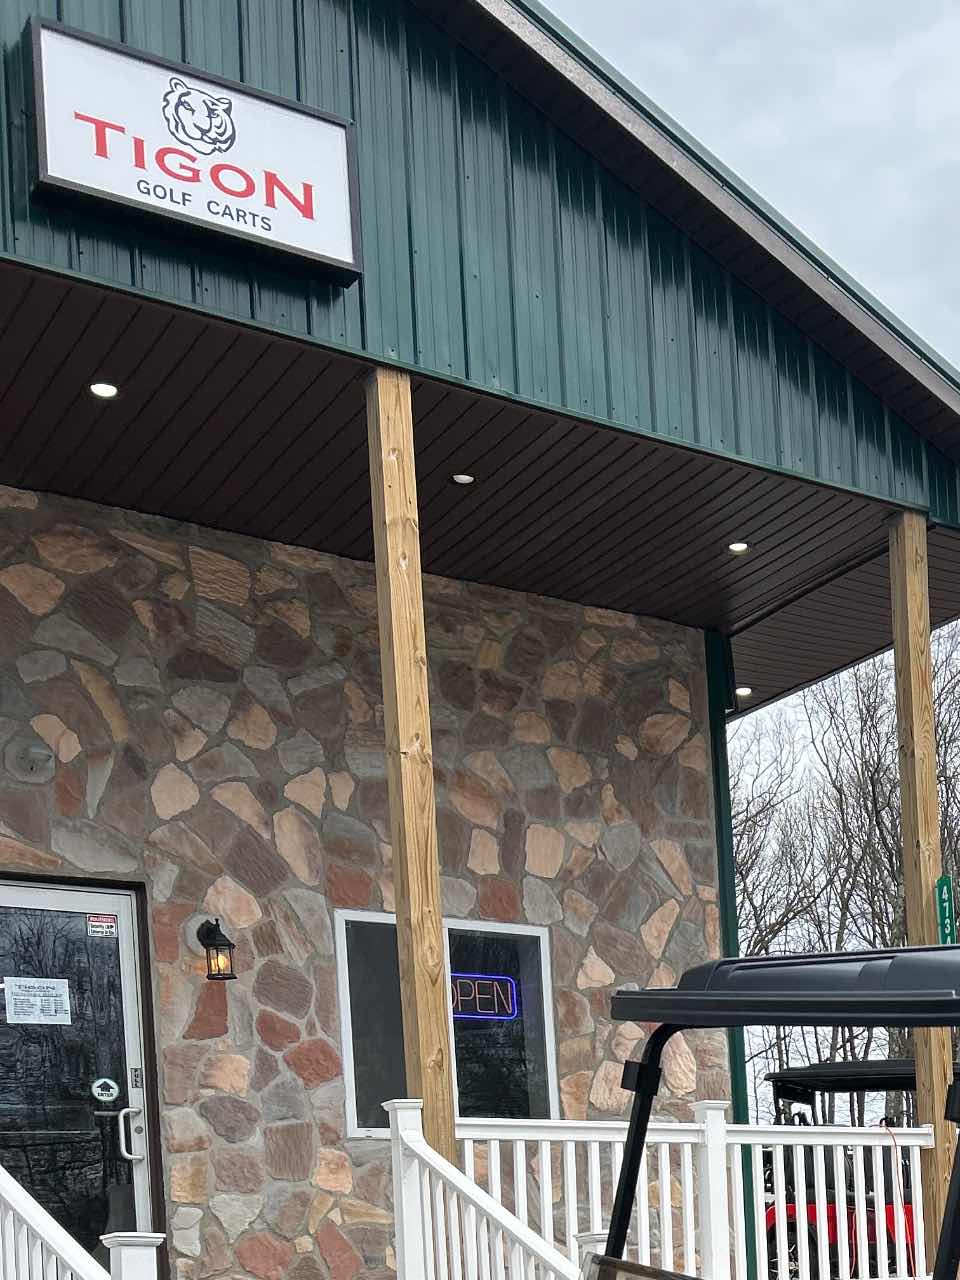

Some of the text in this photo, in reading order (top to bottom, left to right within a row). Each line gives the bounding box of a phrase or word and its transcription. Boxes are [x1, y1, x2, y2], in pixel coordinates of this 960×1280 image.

[74, 111, 314, 221] TIGON
[136, 179, 272, 232] GOLF CARTS
